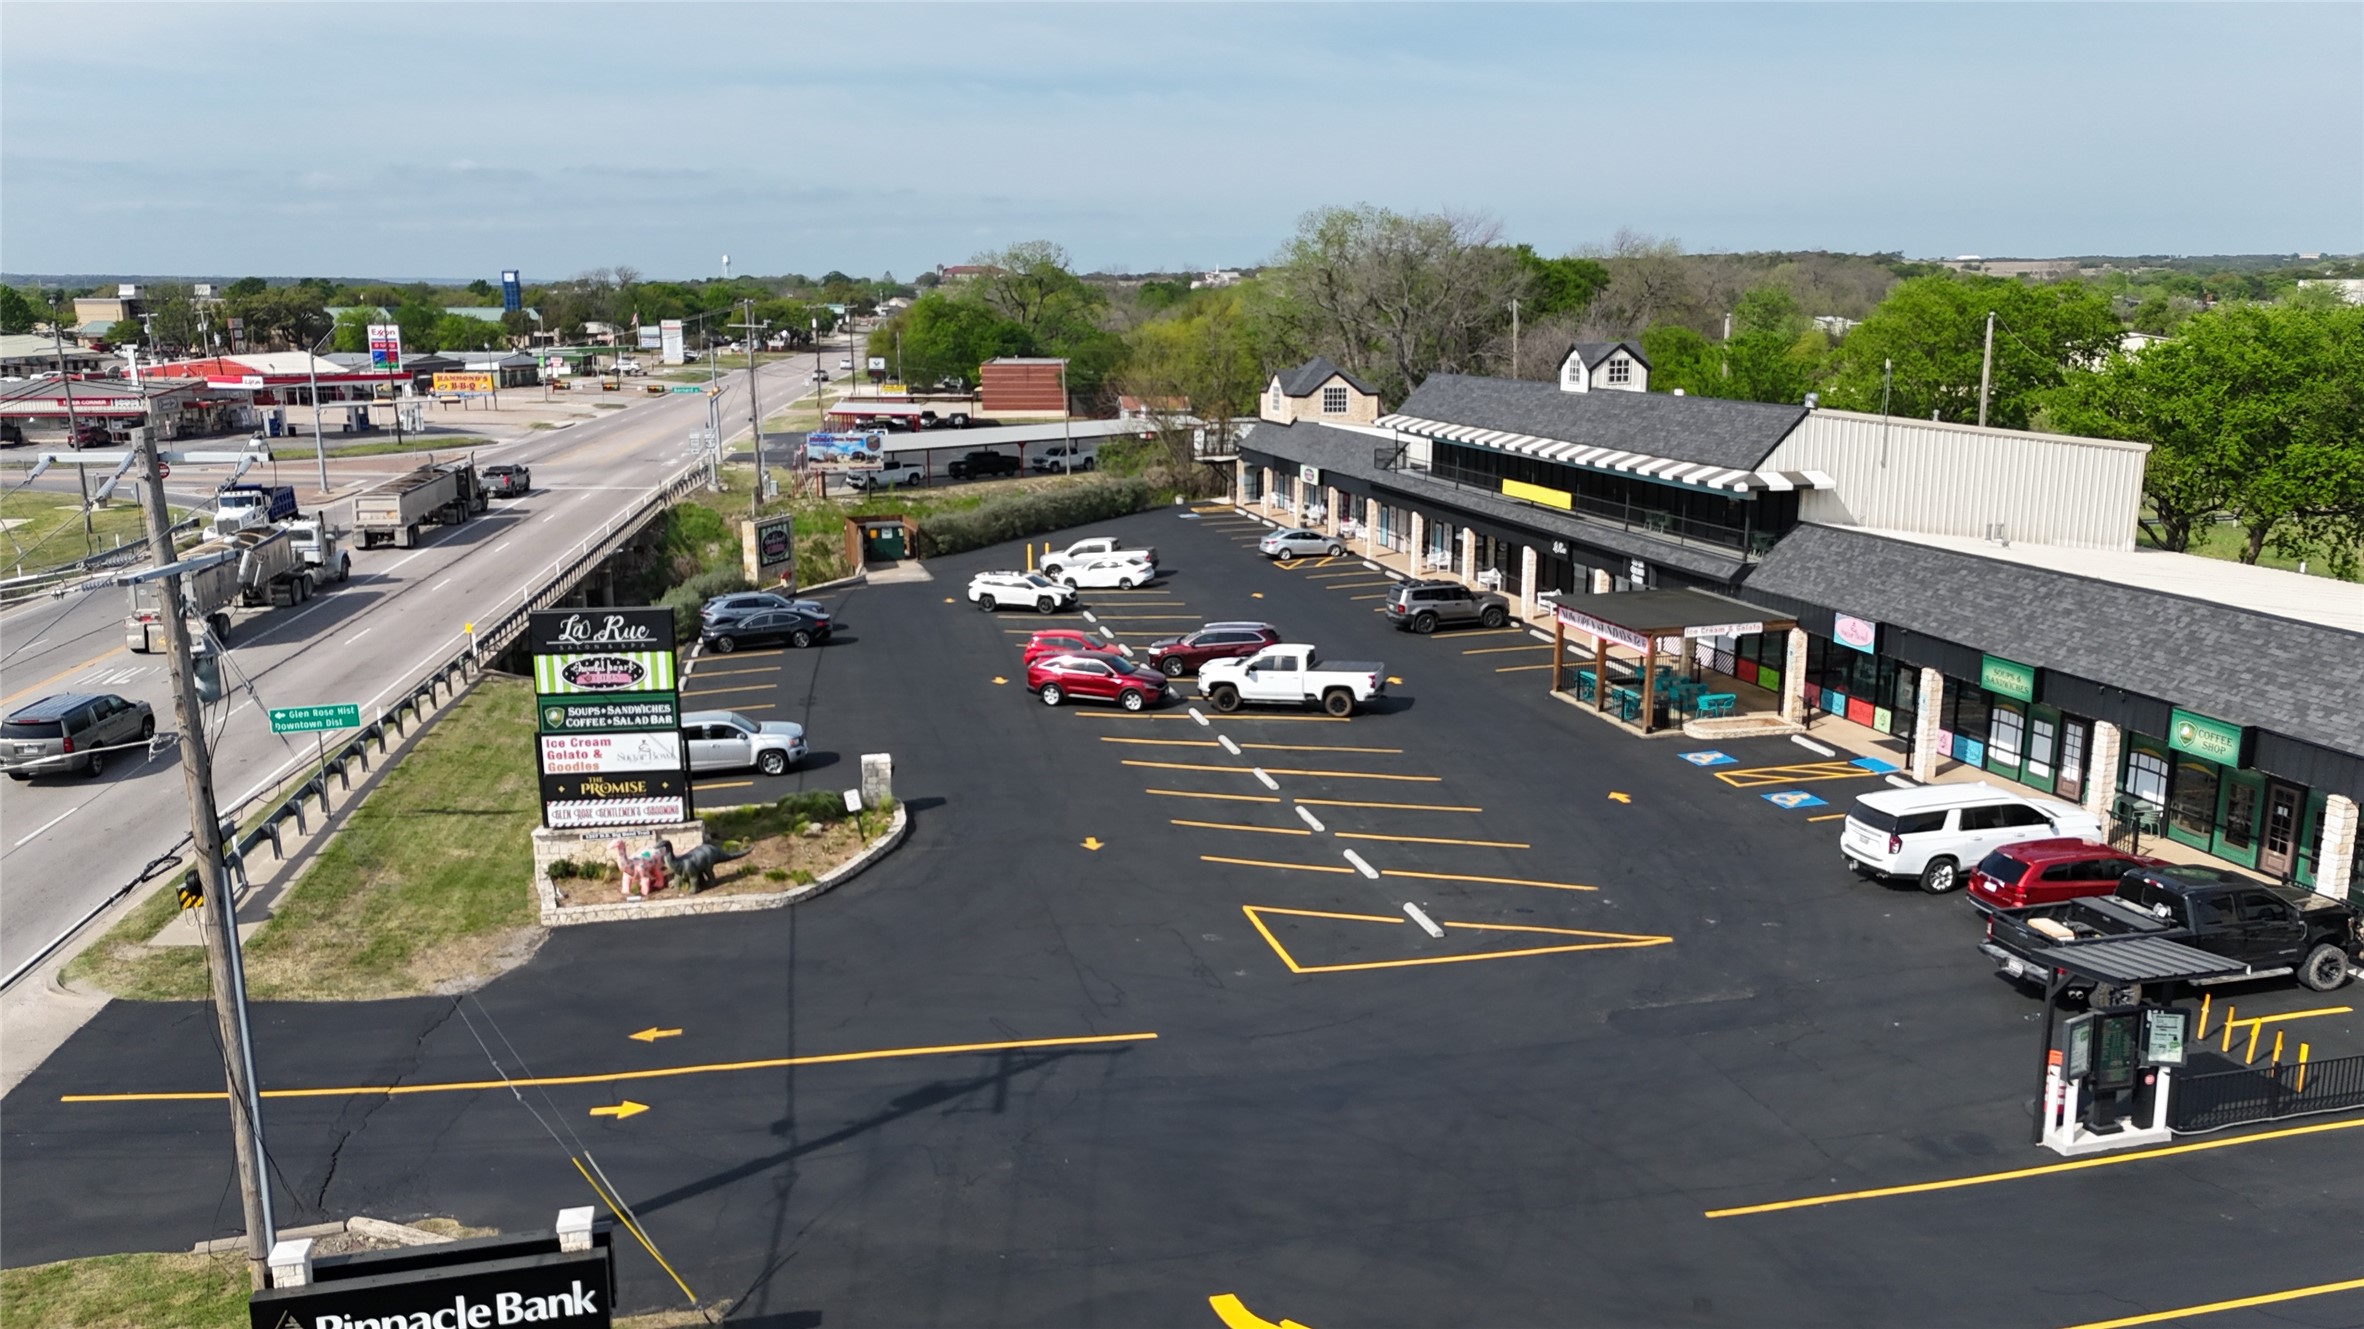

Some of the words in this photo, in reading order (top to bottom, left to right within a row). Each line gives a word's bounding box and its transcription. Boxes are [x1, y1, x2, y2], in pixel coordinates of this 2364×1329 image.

[558, 614, 584, 644] La
[1701, 626, 1725, 634] Cream
[288, 710, 310, 718] Glen
[312, 708, 334, 717] Rose
[337, 706, 354, 714] Hist
[568, 706, 600, 717] SOUPS
[607, 704, 671, 716] SANDWICHES
[275, 720, 322, 730] Downtown
[326, 718, 343, 726] Dist
[566, 718, 607, 728] COFFEE
[612, 716, 648, 726] SALAD
[650, 715, 673, 725] BAR
[546, 738, 566, 748] Ice
[570, 738, 612, 748] Cream
[2198, 729, 2233, 748] COFFEE
[2202, 741, 2226, 754] SHOP
[547, 750, 588, 760] Gelato
[594, 750, 603, 759] &
[580, 781, 647, 797] PROMISE
[552, 809, 572, 820] GLEN
[574, 808, 593, 820] ROSE
[643, 805, 679, 816] GROOMING
[496, 1280, 598, 1325] Bank
